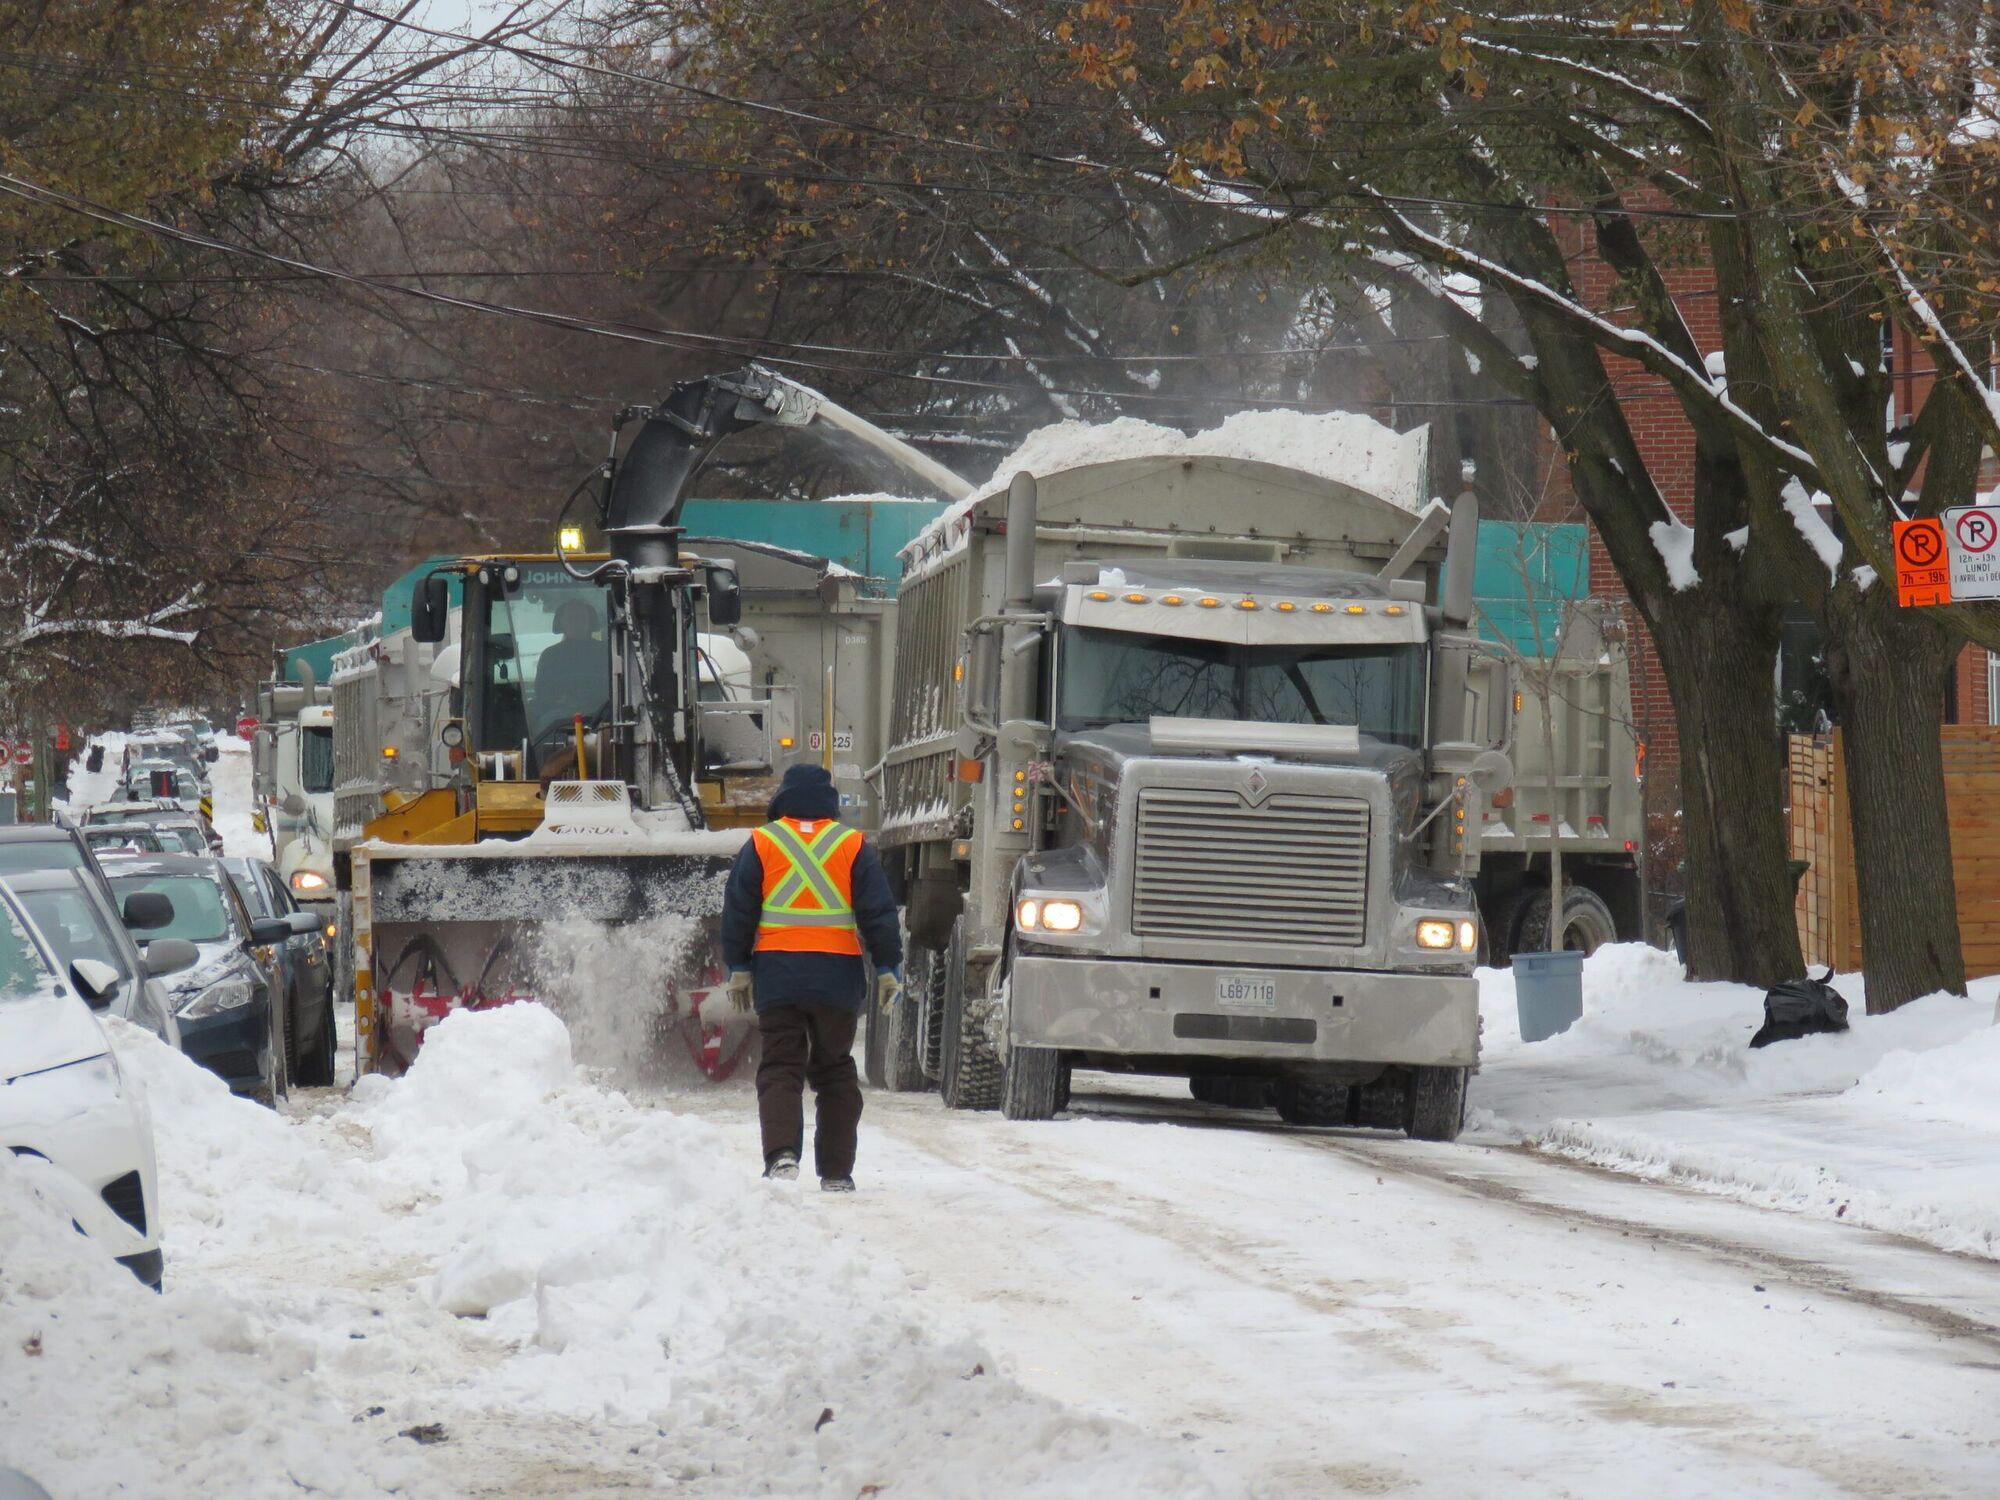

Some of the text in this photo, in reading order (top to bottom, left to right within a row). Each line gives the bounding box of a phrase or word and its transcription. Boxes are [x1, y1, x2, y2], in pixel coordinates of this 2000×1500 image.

[1959, 554, 1973, 563] 12h
[1983, 553, 1996, 562] 13h
[1965, 563, 1990, 573] LUNDI
[522, 570, 572, 584] JOHN
[1902, 573, 1914, 585] 7h
[1928, 570, 1945, 584] 19h
[1220, 984, 1274, 1000] L687118
